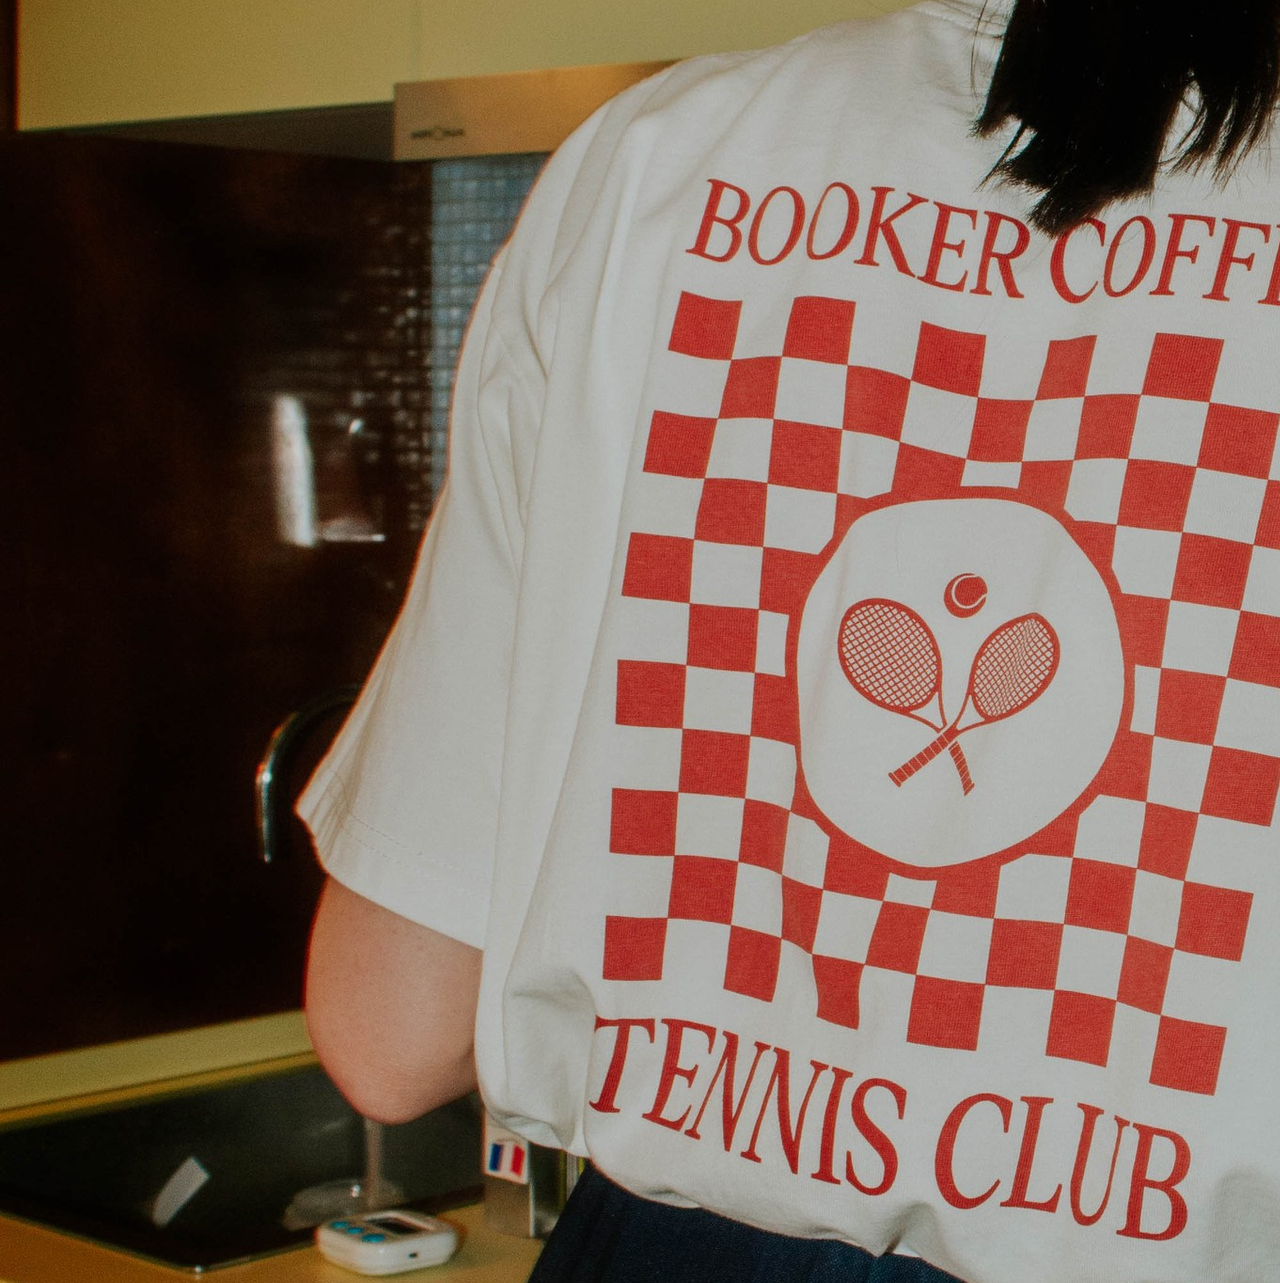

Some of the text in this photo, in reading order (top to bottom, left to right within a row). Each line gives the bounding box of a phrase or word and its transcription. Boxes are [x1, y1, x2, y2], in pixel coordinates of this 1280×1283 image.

[686, 178, 1031, 299] BOOKER
[589, 1017, 1192, 1241] TENNIS CLUB
